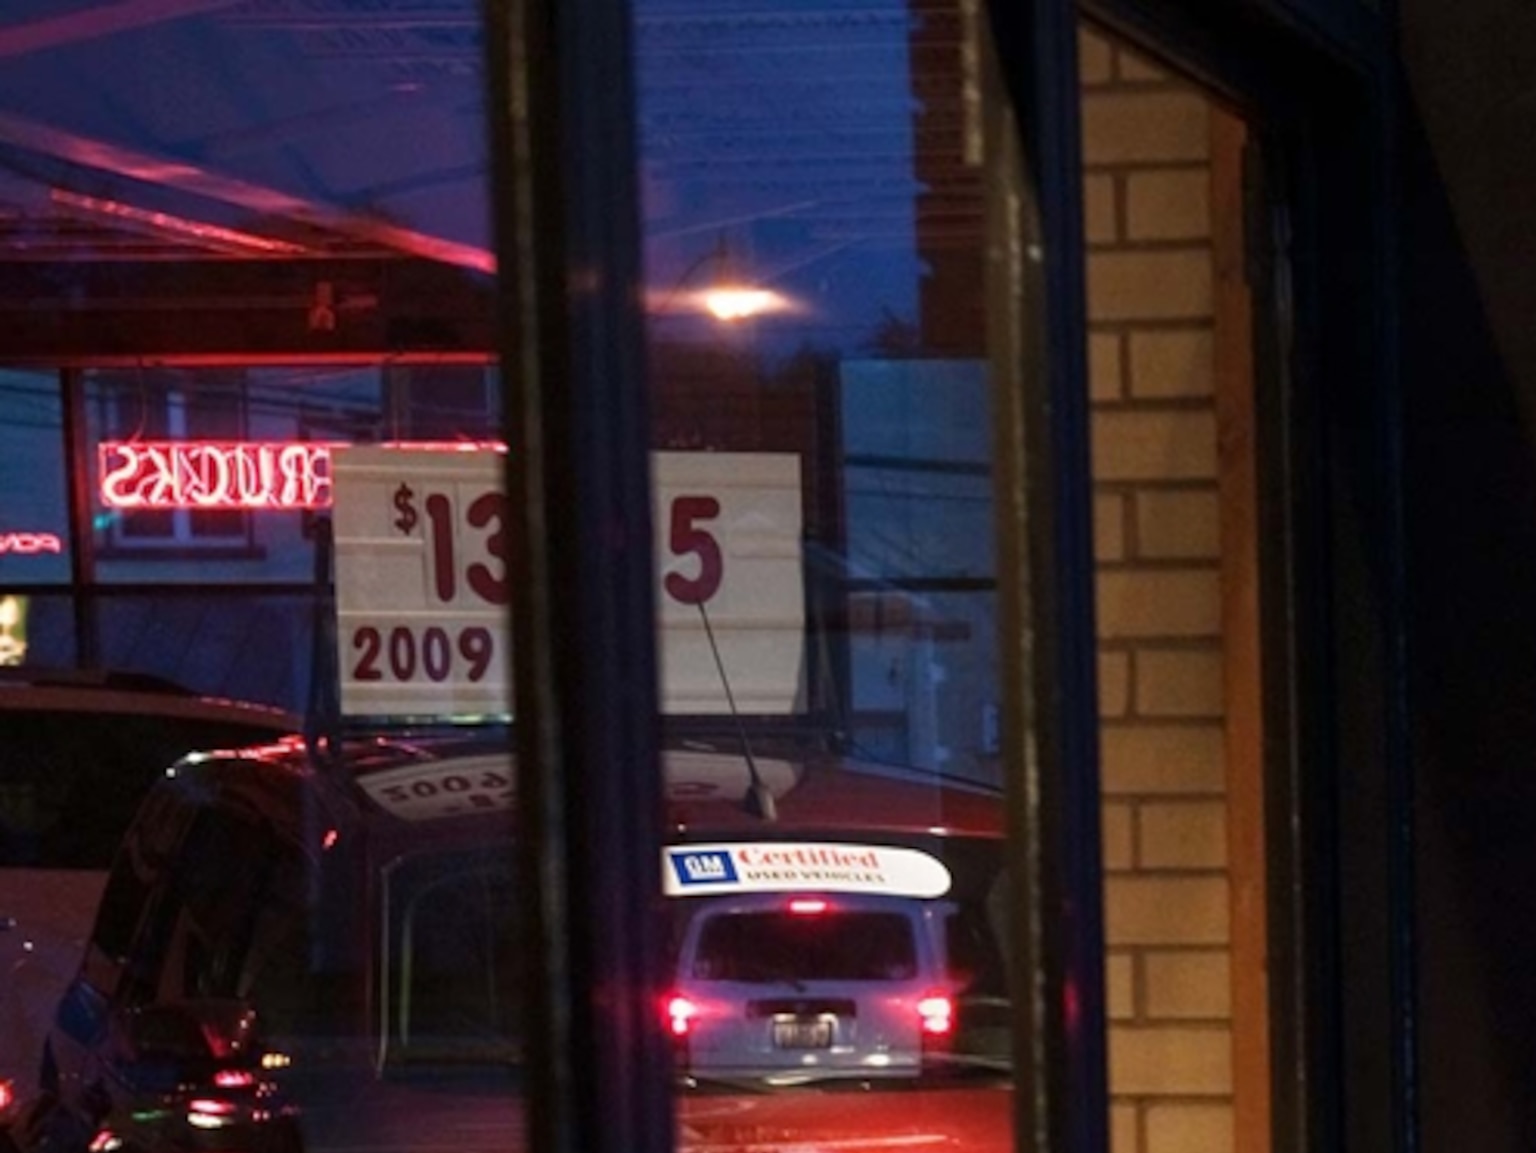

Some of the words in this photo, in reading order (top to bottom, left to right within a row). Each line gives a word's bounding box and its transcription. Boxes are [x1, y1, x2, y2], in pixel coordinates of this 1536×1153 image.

[353, 626, 493, 683] 2009
[684, 855, 725, 875] GM
[738, 848, 880, 869] Certified
[746, 871, 798, 880] USED
[800, 871, 886, 883] VEHICLES
